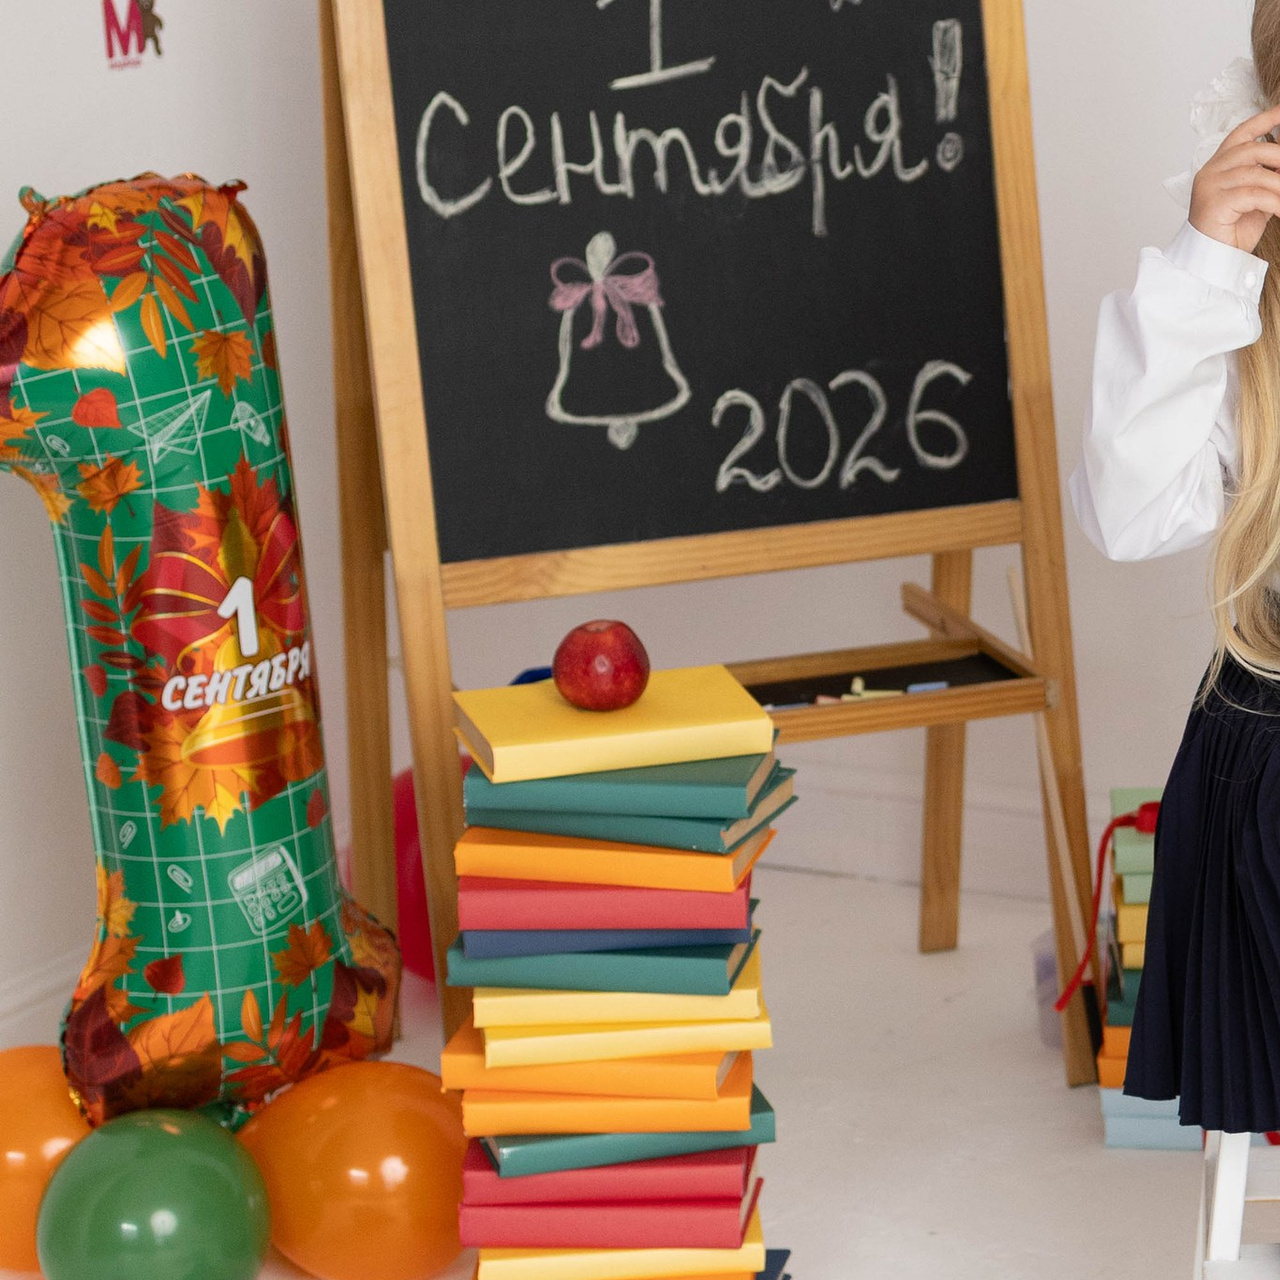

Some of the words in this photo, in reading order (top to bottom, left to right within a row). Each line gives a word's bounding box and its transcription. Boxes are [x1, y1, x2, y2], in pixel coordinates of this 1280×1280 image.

[711, 359, 973, 493] 2026
[217, 576, 259, 658] 1
[161, 640, 311, 711] СЕНТЯБРЯ
